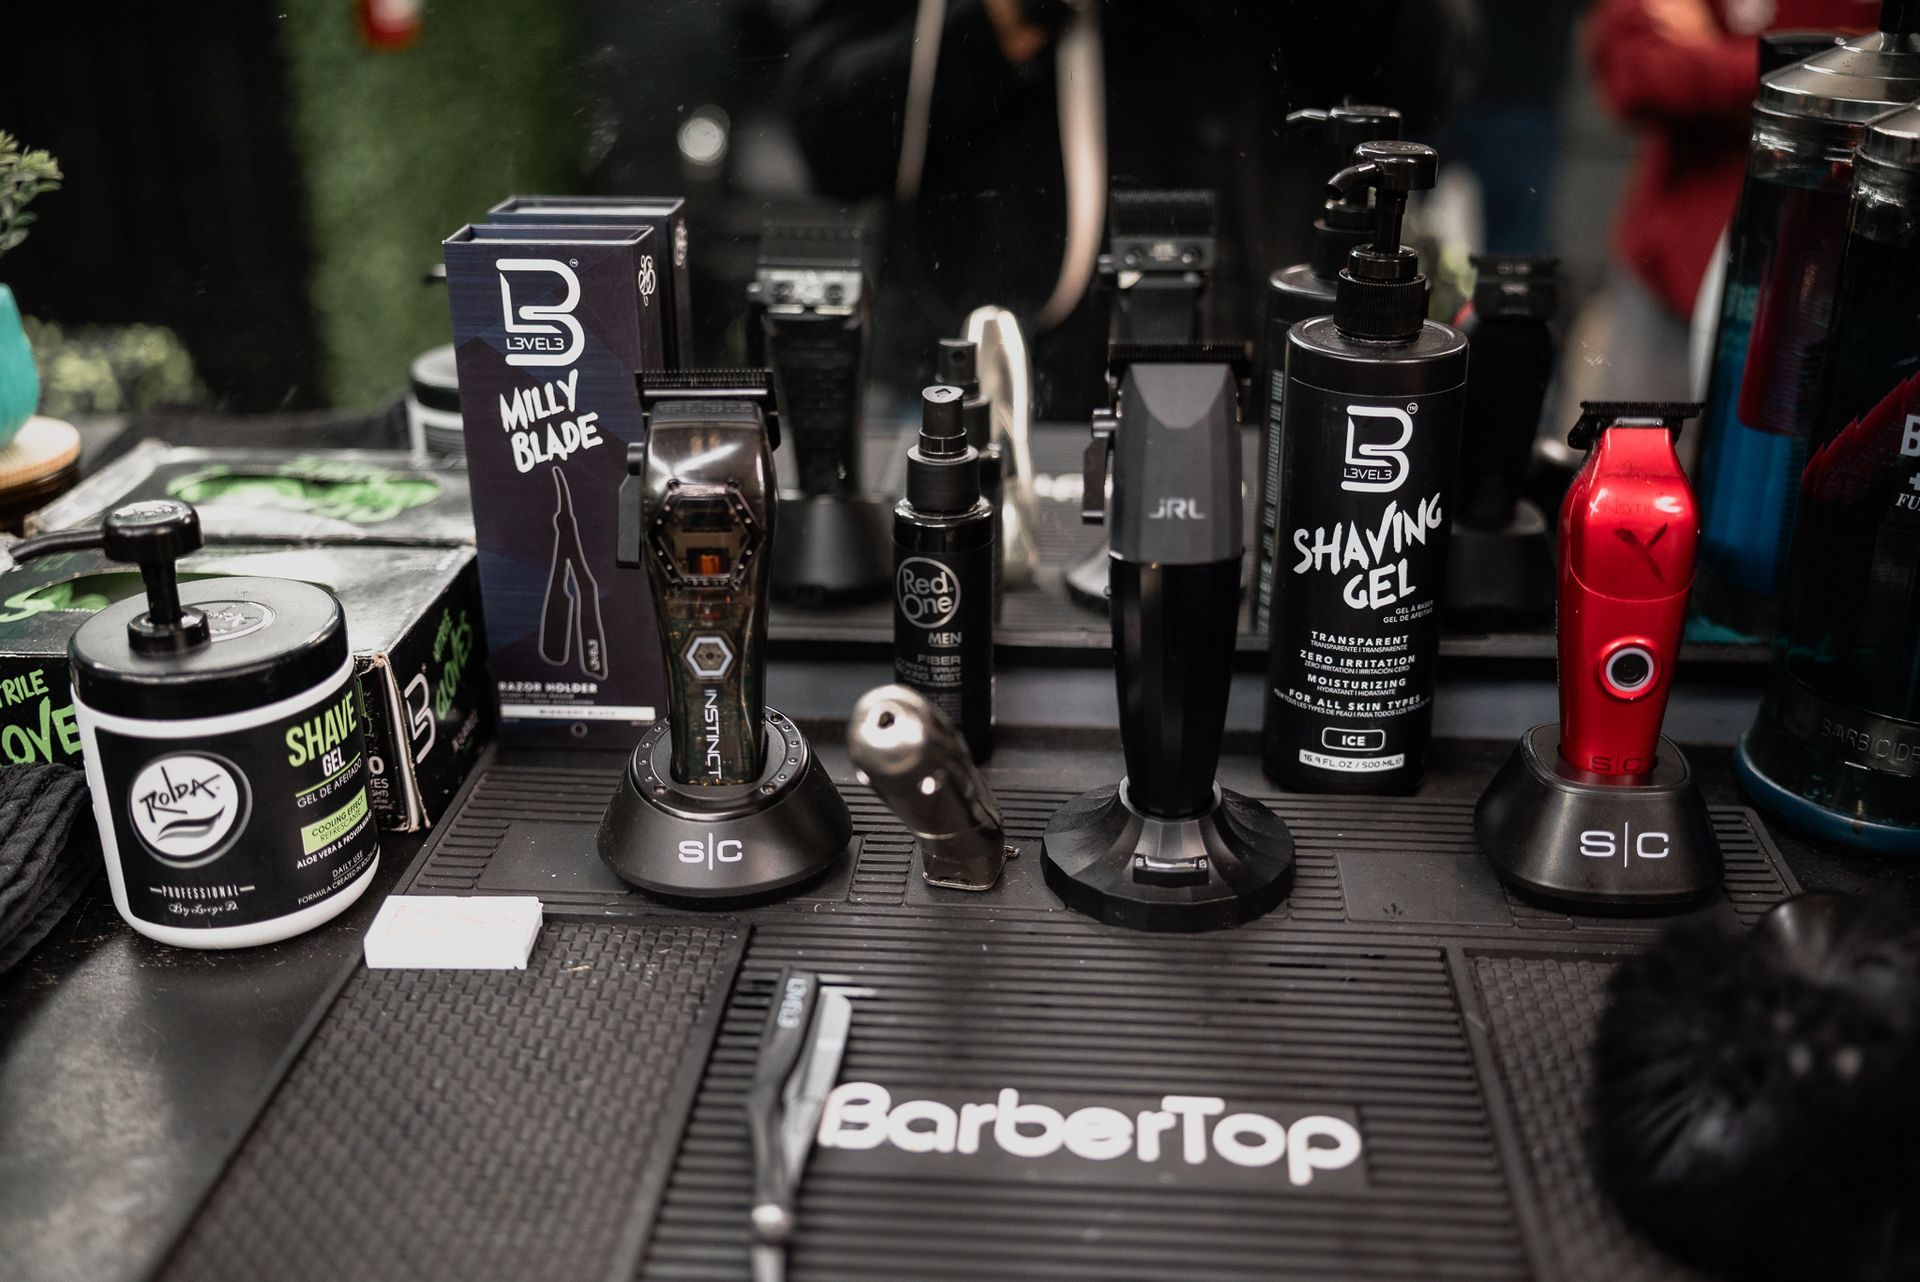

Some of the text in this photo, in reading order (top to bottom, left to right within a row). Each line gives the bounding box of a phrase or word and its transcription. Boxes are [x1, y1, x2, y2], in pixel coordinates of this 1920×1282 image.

[500, 368, 578, 433] MILLY
[511, 412, 603, 474] BLADE
[1148, 498, 1205, 519] JRL
[1895, 493, 1920, 511] FU
[1293, 492, 1442, 575] SHAVING
[1343, 558, 1416, 610] GEL
[902, 593, 953, 619] One
[1395, 606, 1410, 615] GEL
[1383, 614, 1398, 623] GEL
[1399, 613, 1410, 622] DE
[928, 631, 962, 644] MEN
[1310, 639, 1358, 653] TRANSPARENTE
[1362, 643, 1408, 653] TRANSPARENTE
[1311, 630, 1409, 646] TRANSPARENT
[1300, 649, 1416, 668] ZERO IRRITATION
[1320, 664, 1355, 675] IRRITATION
[498, 681, 598, 694] RAZOR HOLDER
[1307, 673, 1407, 690] MOISTURIZING
[1316, 685, 1354, 696] HYDRATANT
[1358, 688, 1396, 697] HIDRATANTE
[1288, 688, 1311, 703] FOR
[1316, 698, 1341, 710] ALL
[1347, 702, 1381, 711] SKIN
[1387, 694, 1420, 710] TYPES
[1297, 701, 1307, 709] LES
[1308, 704, 1325, 714] TYPES
[1325, 708, 1335, 716] DE
[1336, 709, 1353, 717] PEAU
[1357, 710, 1374, 718] PARA
[1373, 709, 1396, 718] TODOS
[285, 690, 357, 768] SHAVE
[704, 688, 722, 779] INSTINCT
[1341, 735, 1366, 746] ICE
[321, 746, 346, 777] GEL
[1361, 760, 1380, 768] 500
[1382, 758, 1395, 766] ML
[297, 758, 362, 808] GEL DE AFEITADO
[311, 811, 347, 837] COOLING
[348, 795, 364, 816] EFFECT
[320, 809, 362, 842] REFRESCANTE
[297, 855, 318, 869] ALOE
[318, 845, 338, 859] VERA
[332, 850, 364, 878] DAILY USE
[161, 885, 240, 899] PROFESSIONAL
[298, 886, 332, 905] FORMULA
[332, 868, 356, 889] CREATED
[168, 902, 190, 917] By
[817, 1081, 1362, 1187] BarberTop
